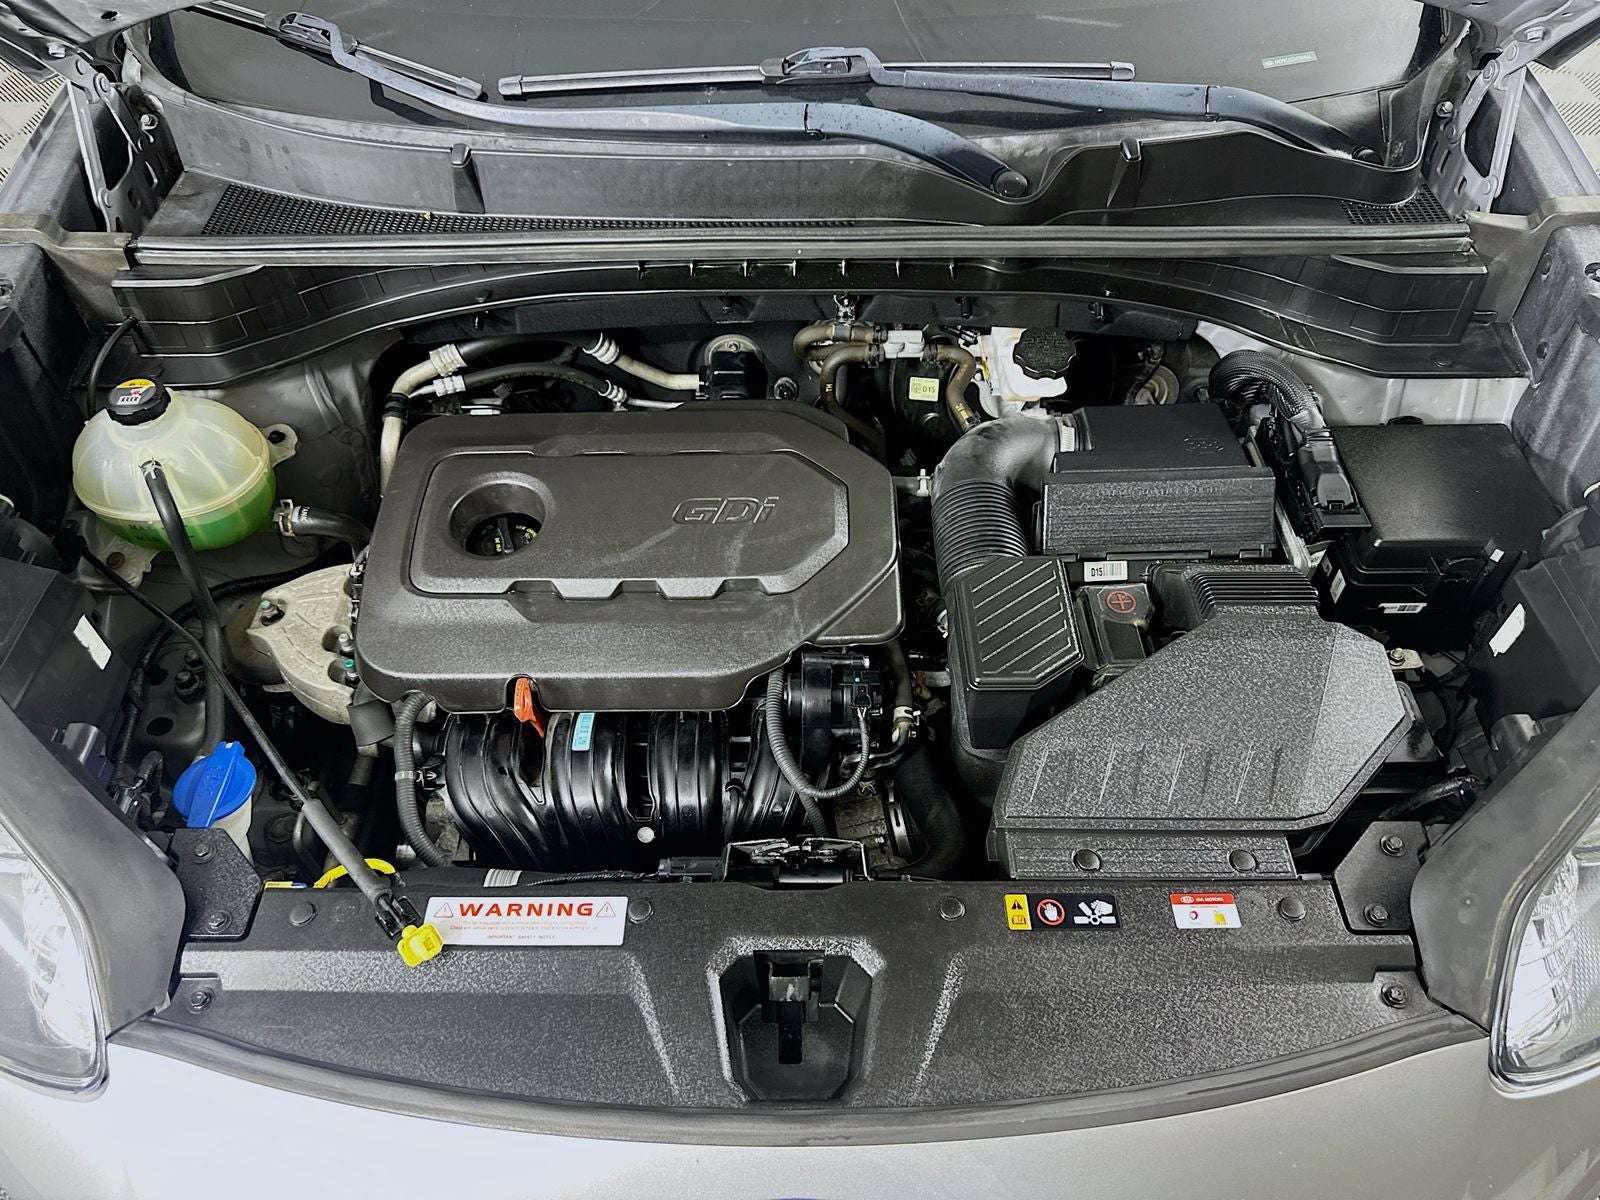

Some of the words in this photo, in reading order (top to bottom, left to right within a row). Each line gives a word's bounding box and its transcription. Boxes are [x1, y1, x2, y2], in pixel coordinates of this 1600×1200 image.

[922, 385, 936, 394] D15
[672, 496, 779, 524] GDi
[1090, 567, 1103, 577] D15
[459, 903, 594, 917] WARNING
